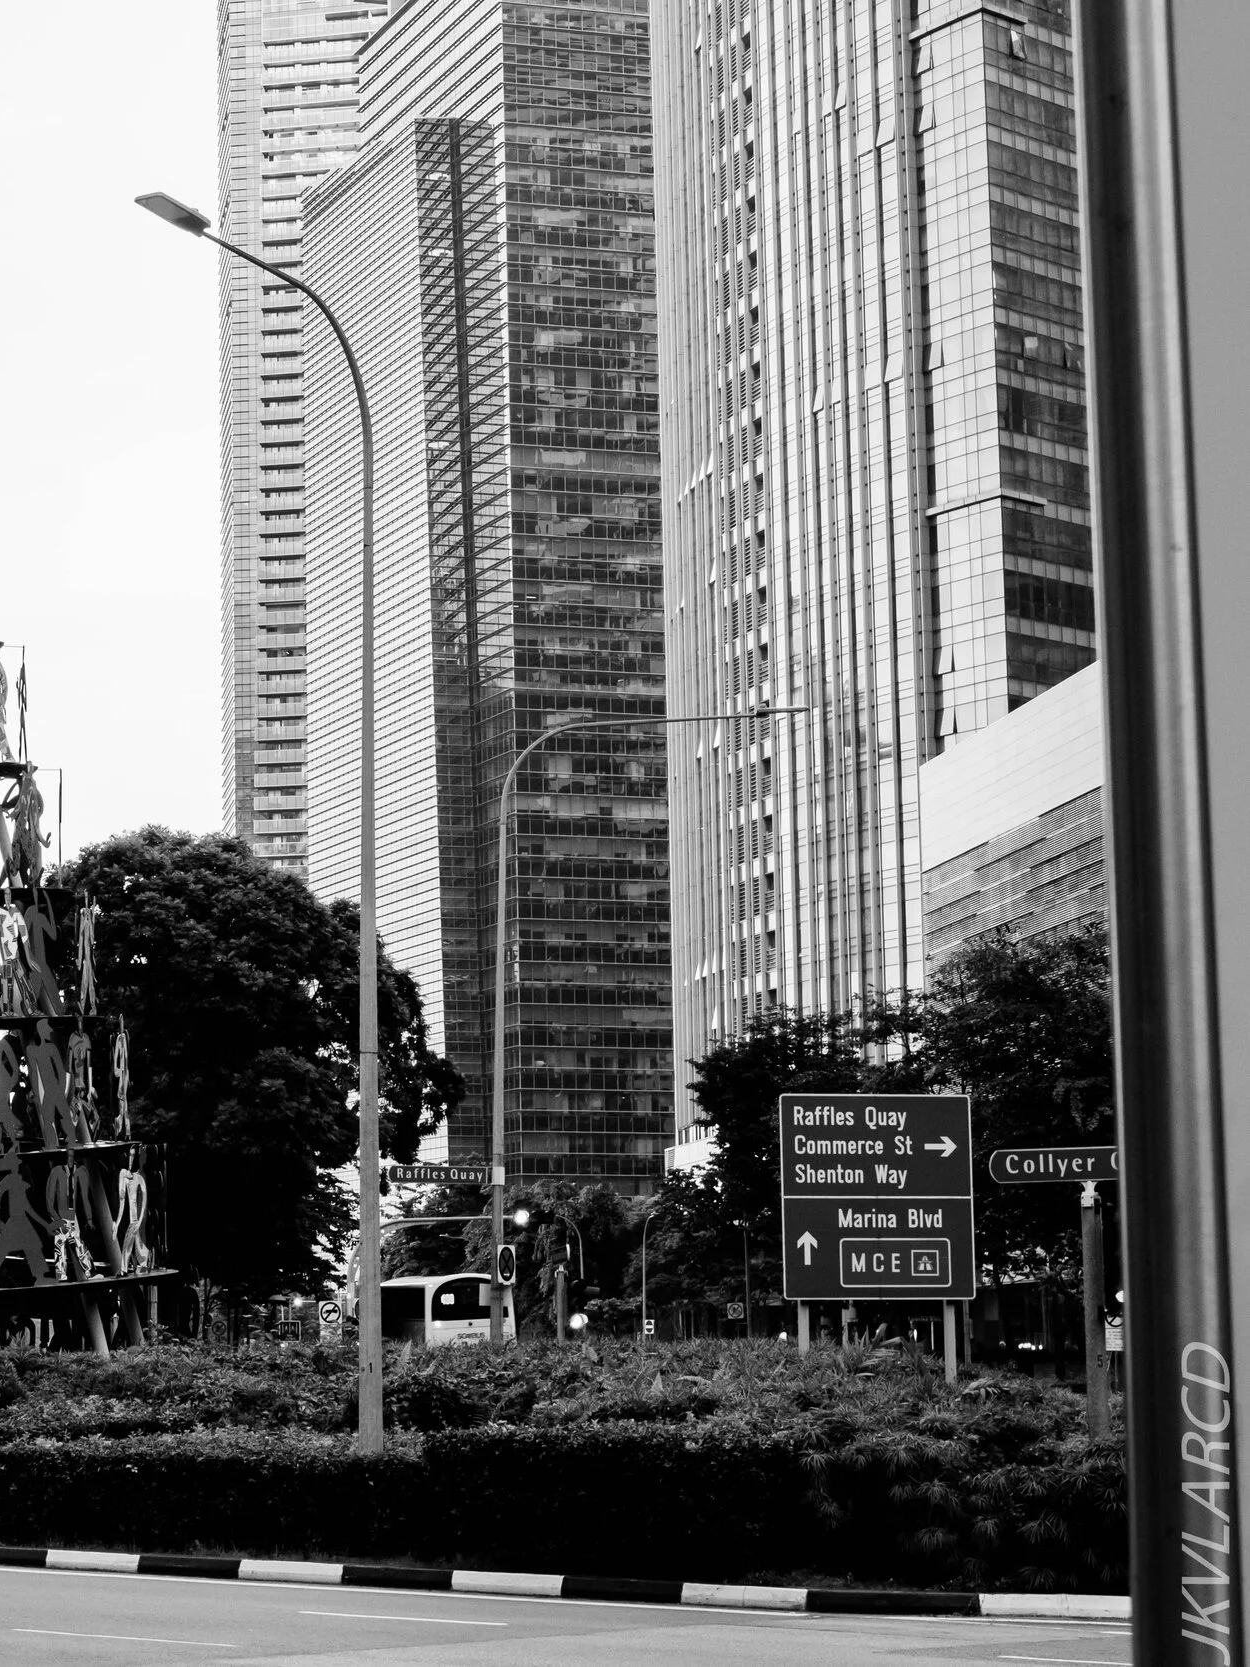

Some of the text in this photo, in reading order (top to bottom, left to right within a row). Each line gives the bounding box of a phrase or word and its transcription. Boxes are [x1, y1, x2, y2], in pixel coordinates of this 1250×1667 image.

[793, 1106, 907, 1131] Raffles Quay
[794, 1135, 913, 1155] Commerce St
[396, 1167, 483, 1183] Raffles Quay
[795, 1163, 908, 1189] Shenton Way
[1005, 1153, 1095, 1178] Collyer
[838, 1208, 943, 1229] Marina Blvd
[851, 1252, 901, 1273] MCE
[1097, 1354, 1104, 1368] 5
